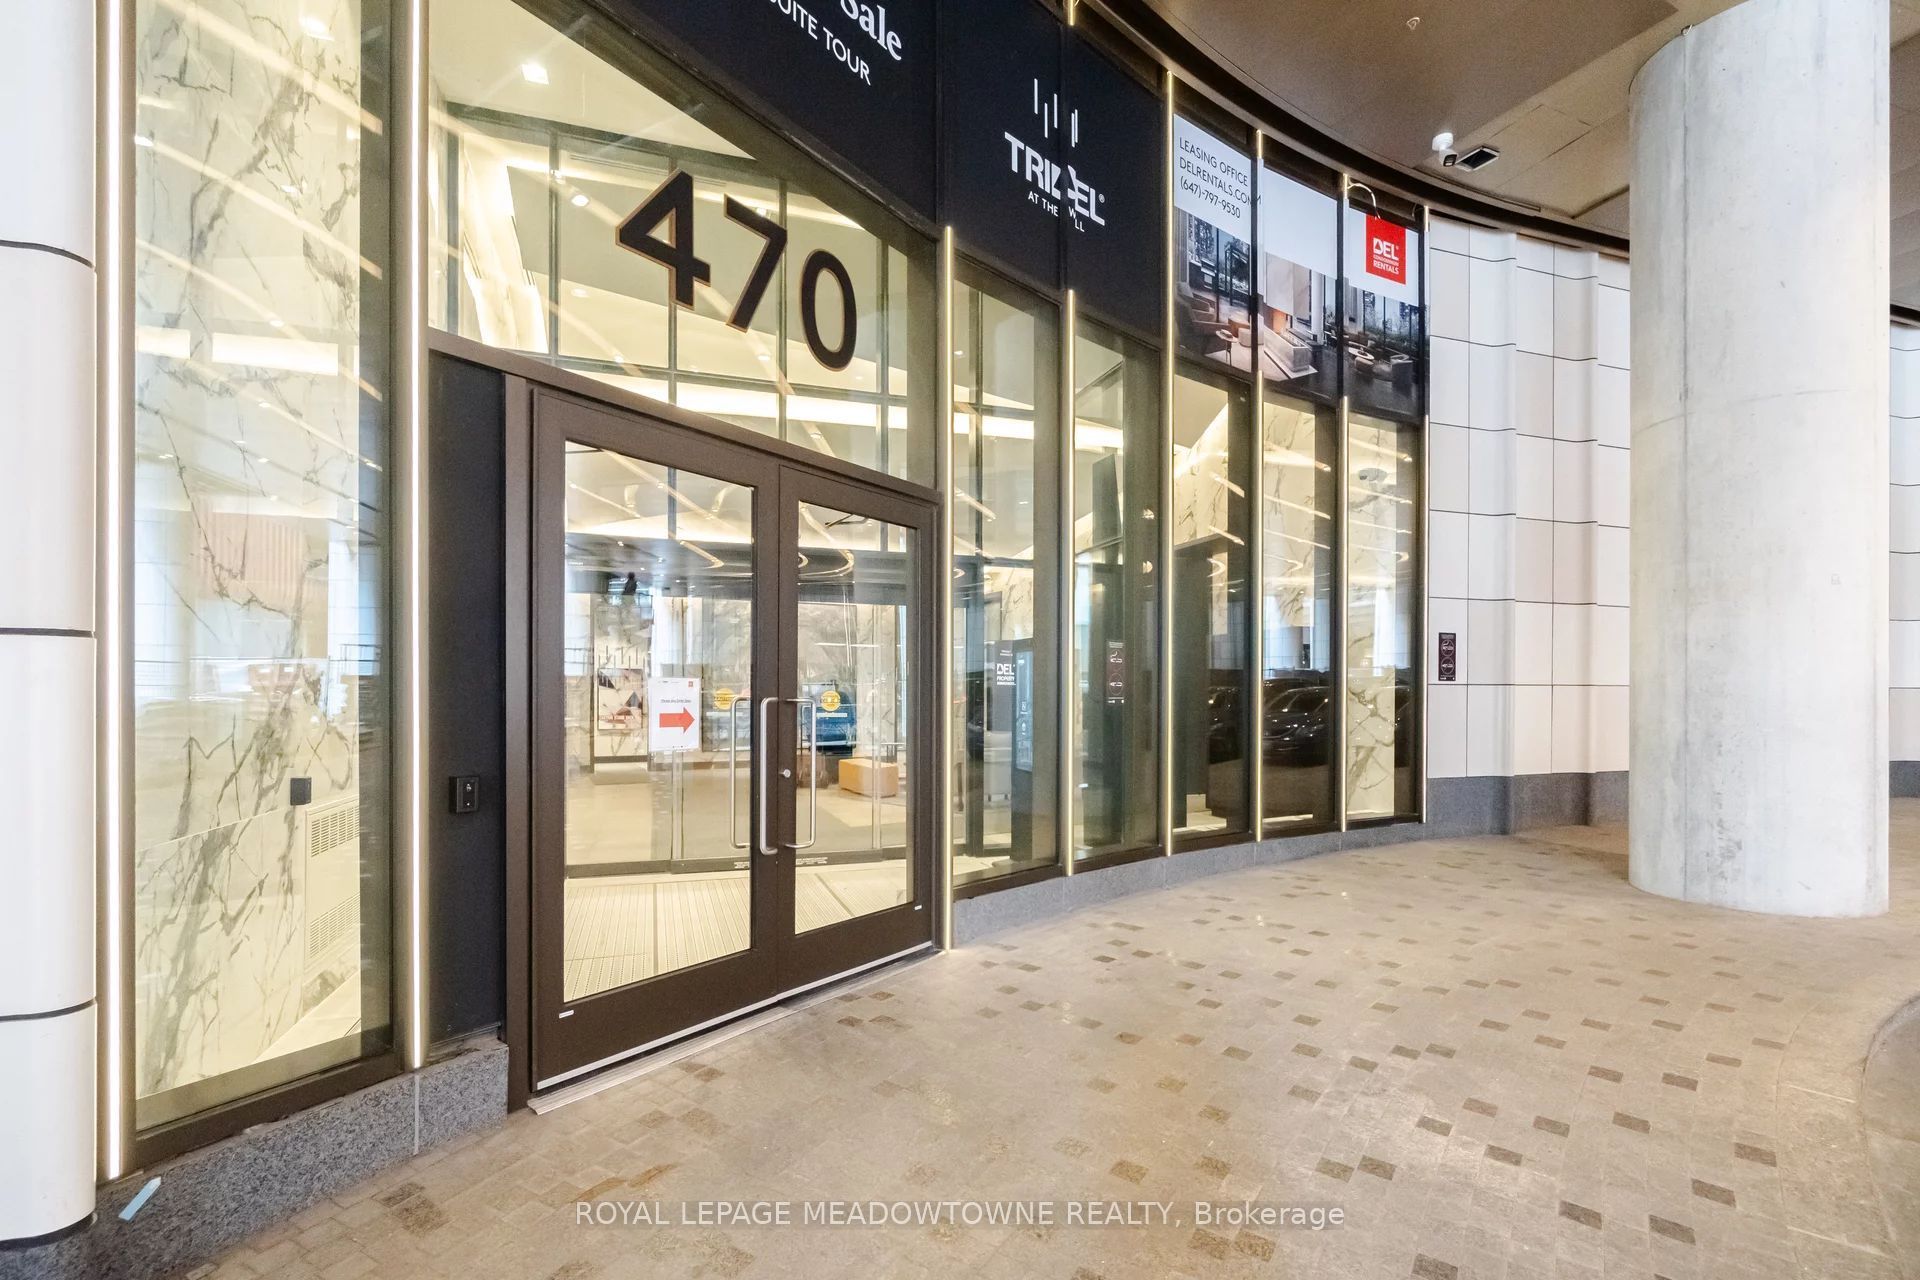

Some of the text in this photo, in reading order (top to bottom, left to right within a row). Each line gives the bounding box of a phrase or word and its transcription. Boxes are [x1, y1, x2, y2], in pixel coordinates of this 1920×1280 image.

[770, 0, 871, 86] UITE TOUR
[1180, 136, 1248, 187] LEASING OFFICE
[1028, 190, 1085, 233] AT THE WLL
[1180, 175, 1241, 219] (647)-797-9530
[615, 168, 857, 372] 470
[1373, 237, 1399, 261] DEL
[1373, 259, 1399, 275] RENTALS
[996, 663, 1015, 675] DEL
